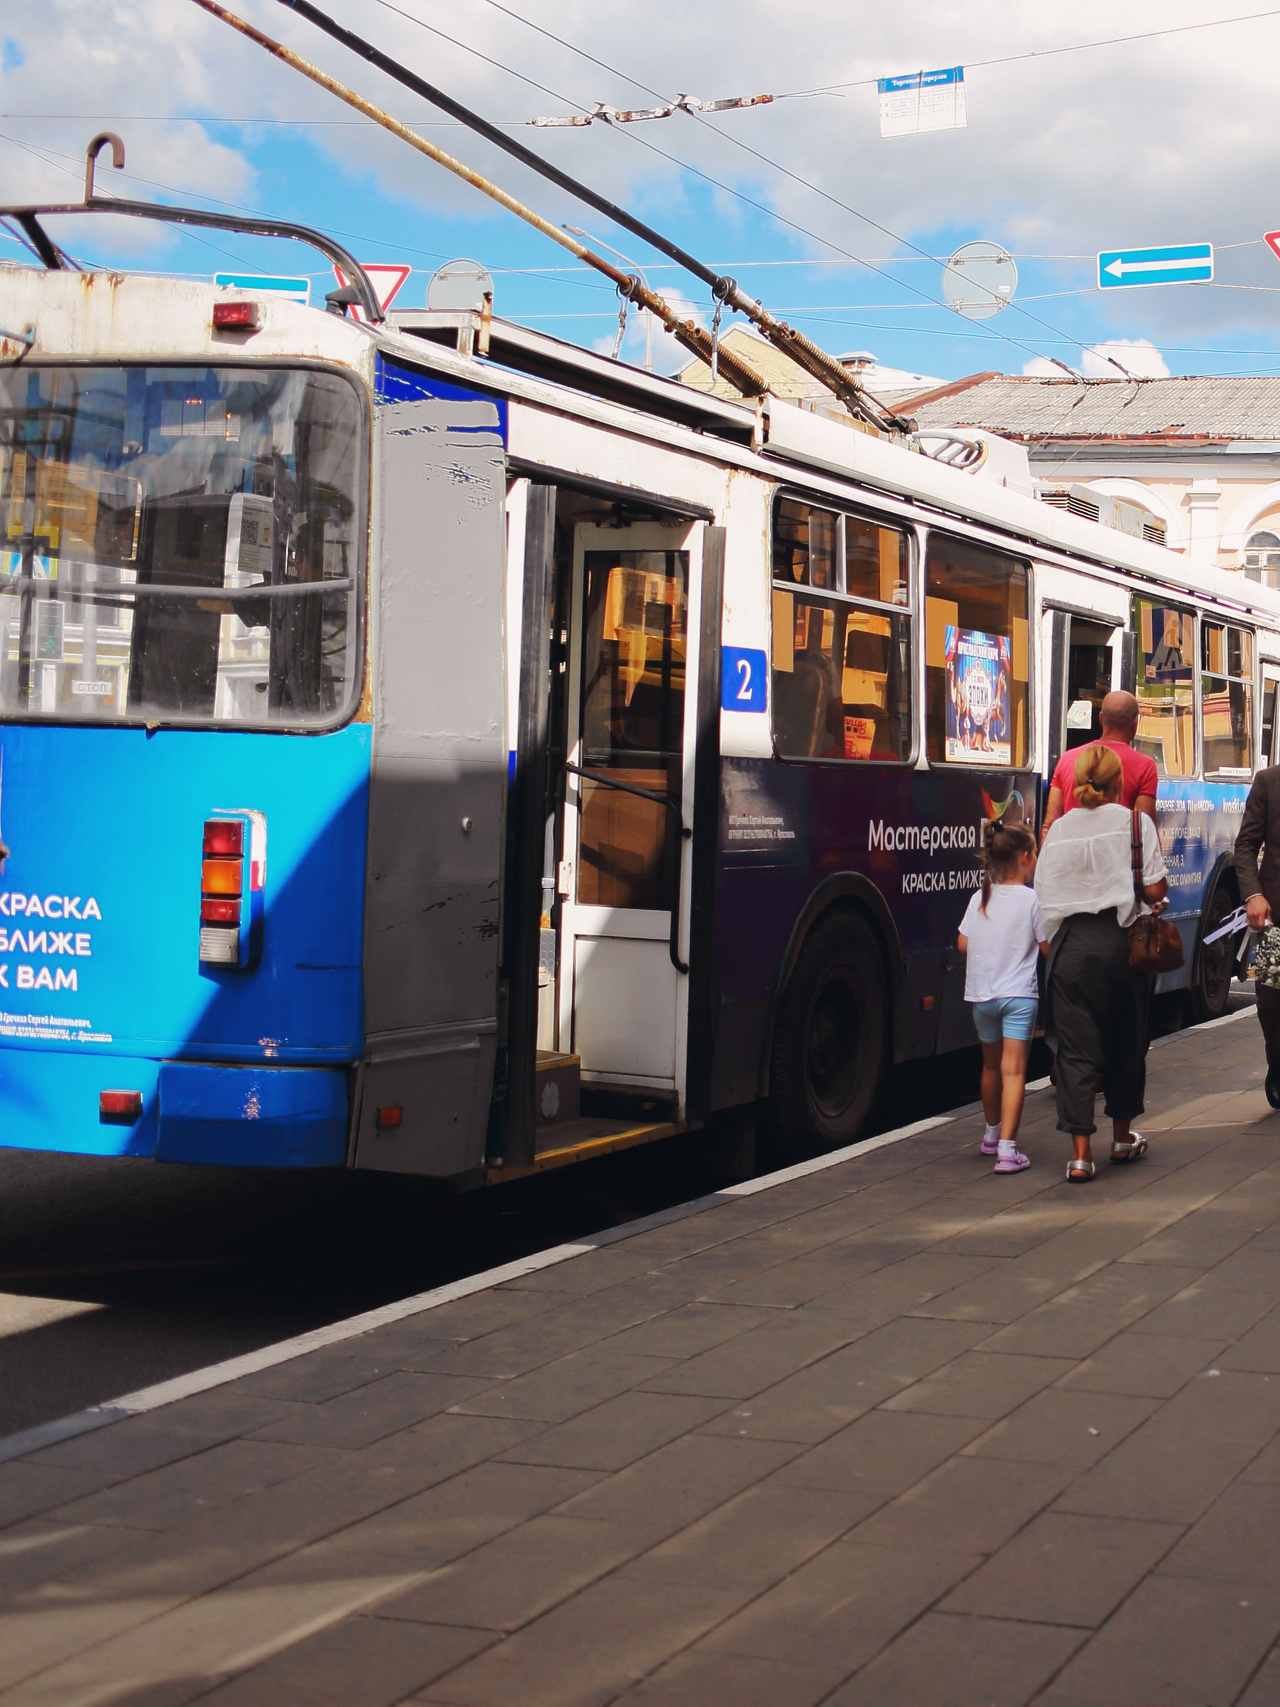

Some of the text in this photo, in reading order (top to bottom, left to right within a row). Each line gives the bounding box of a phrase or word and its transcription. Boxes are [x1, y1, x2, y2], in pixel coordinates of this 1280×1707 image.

[736, 660, 753, 700] 2
[868, 819, 976, 857] Мастерская
[902, 869, 986, 894] КРАСКА БЛИЖЕ
[17, 965, 78, 992] ВАМ
